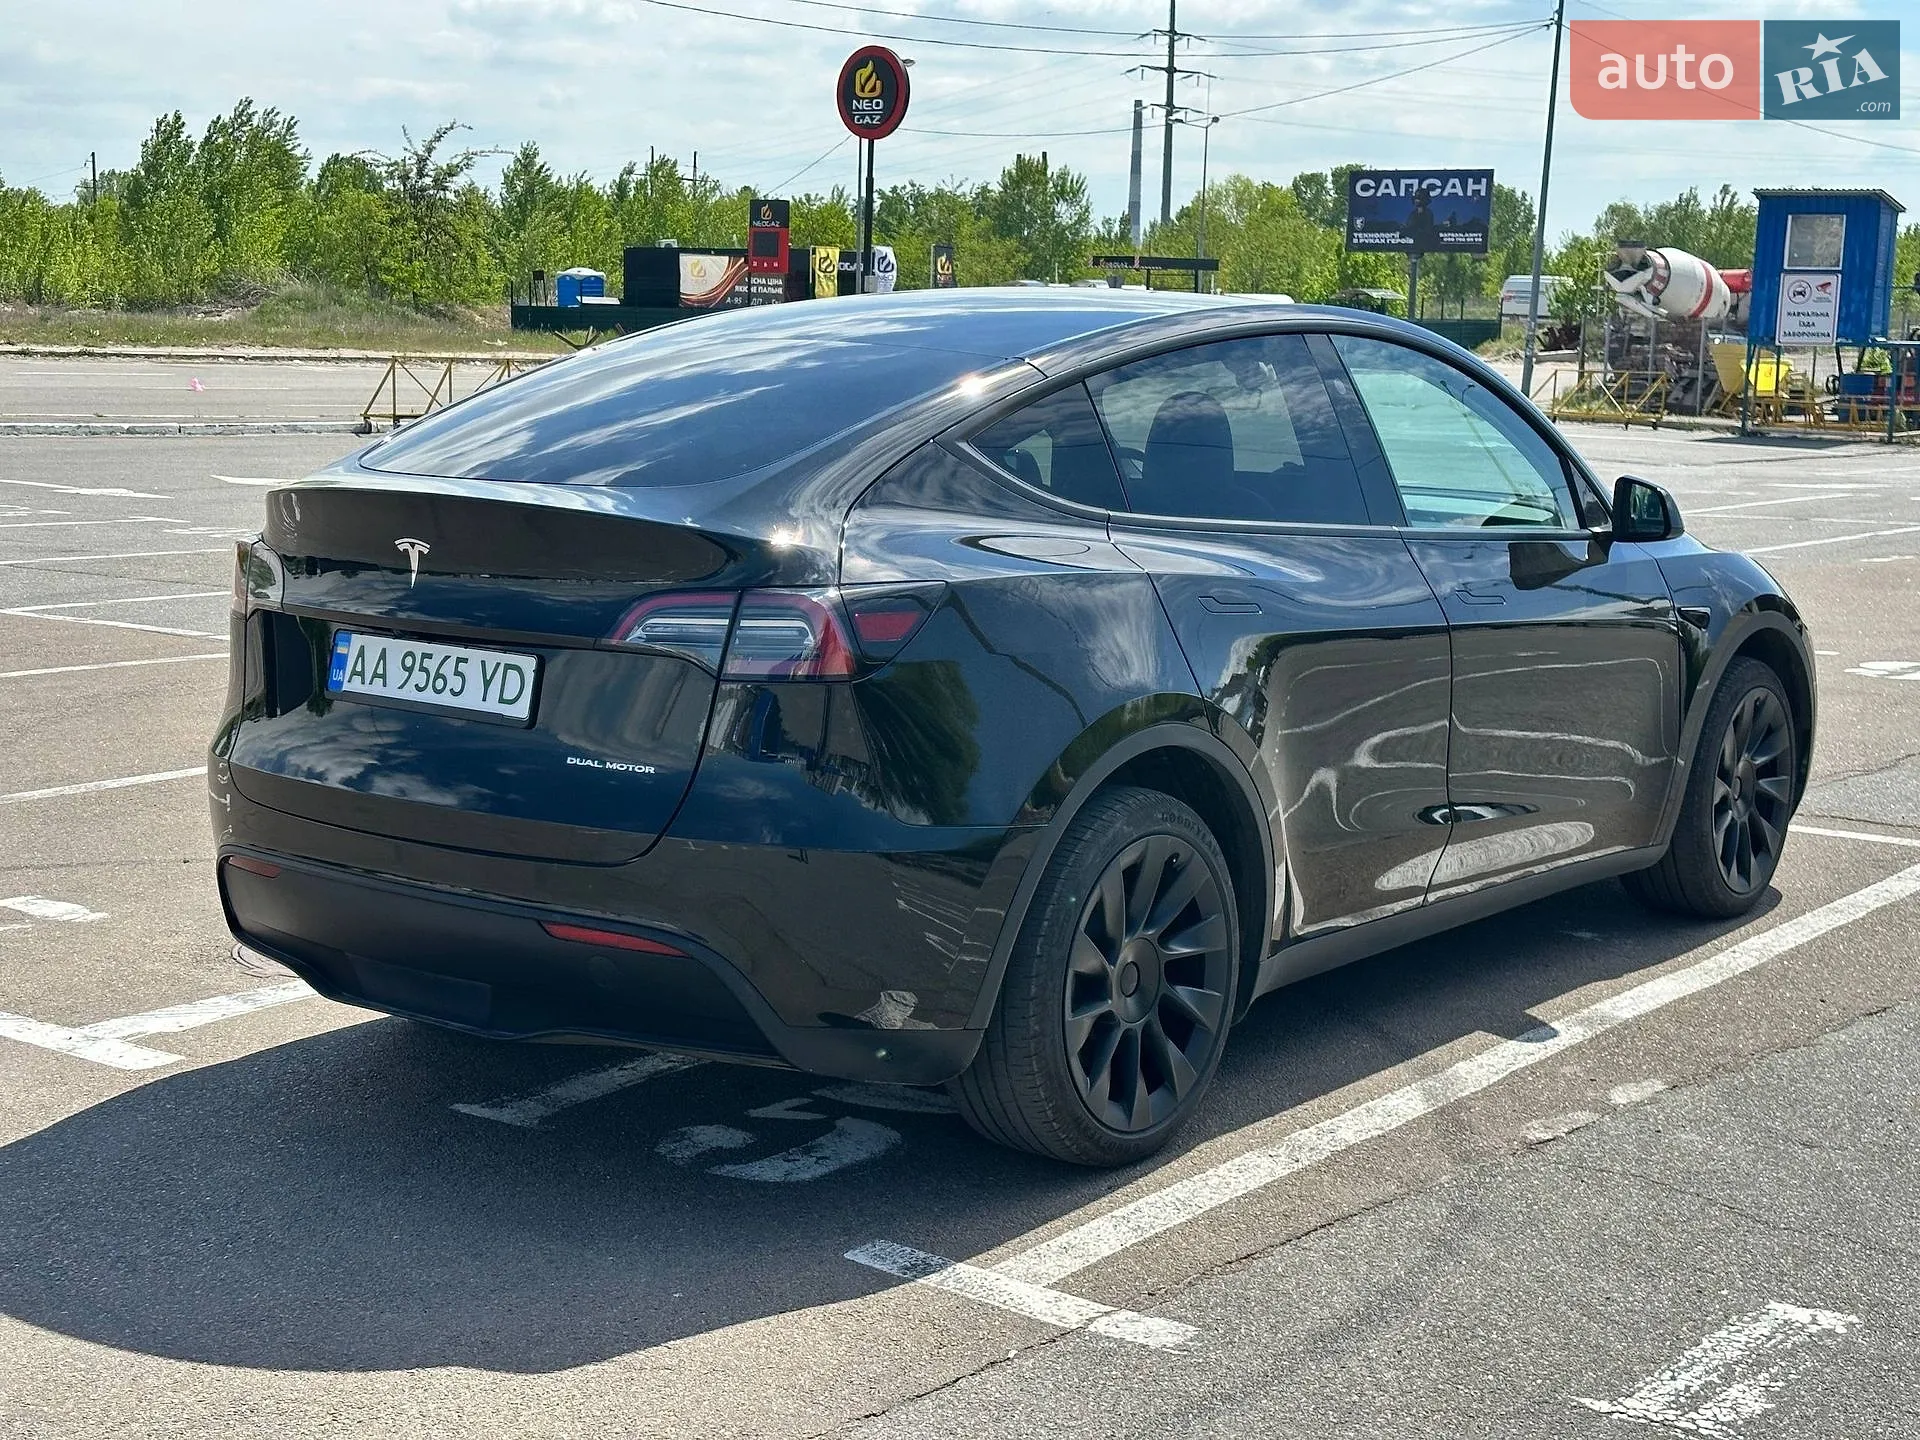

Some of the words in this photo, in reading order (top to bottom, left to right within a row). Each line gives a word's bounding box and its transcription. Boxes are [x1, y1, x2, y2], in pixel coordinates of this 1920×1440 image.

[852, 99, 884, 110] NEO
[854, 115, 881, 124] GAZ
[1355, 178, 1487, 197] САПСАН
[752, 220, 780, 228] NEOGAZ
[332, 669, 344, 681] UA
[347, 645, 387, 687] AA
[397, 650, 469, 697] 9565
[480, 660, 525, 705] YD
[566, 757, 603, 768] DUAL
[605, 761, 655, 774] MOTOR
